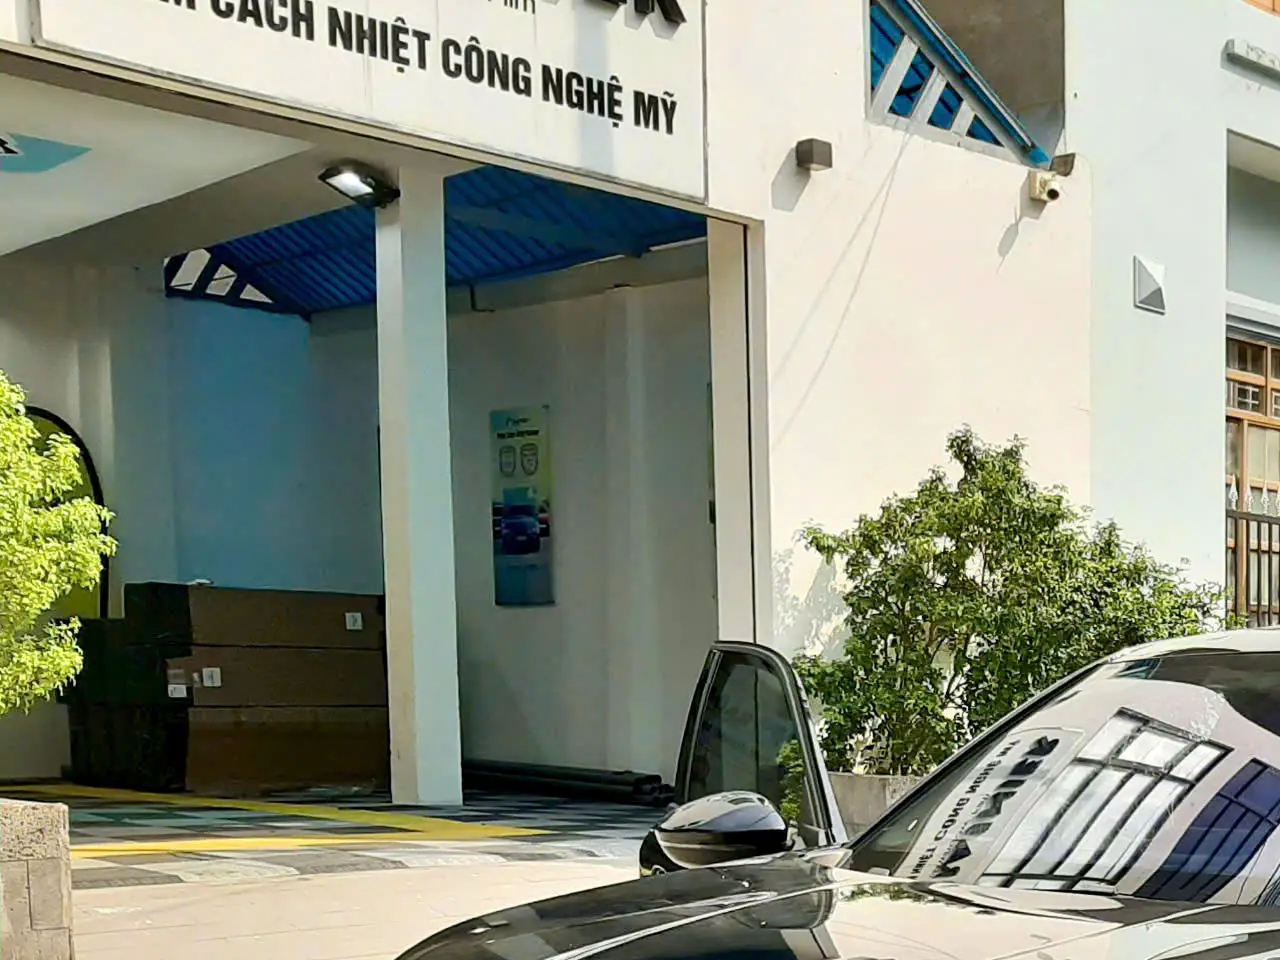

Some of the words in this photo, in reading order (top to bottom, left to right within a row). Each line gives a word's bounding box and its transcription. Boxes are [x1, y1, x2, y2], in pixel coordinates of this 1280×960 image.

[328, 6, 431, 73] NHIỆT
[441, 35, 533, 98] CÔNG
[541, 64, 624, 128] NGHỆ
[633, 89, 678, 135] MỸ
